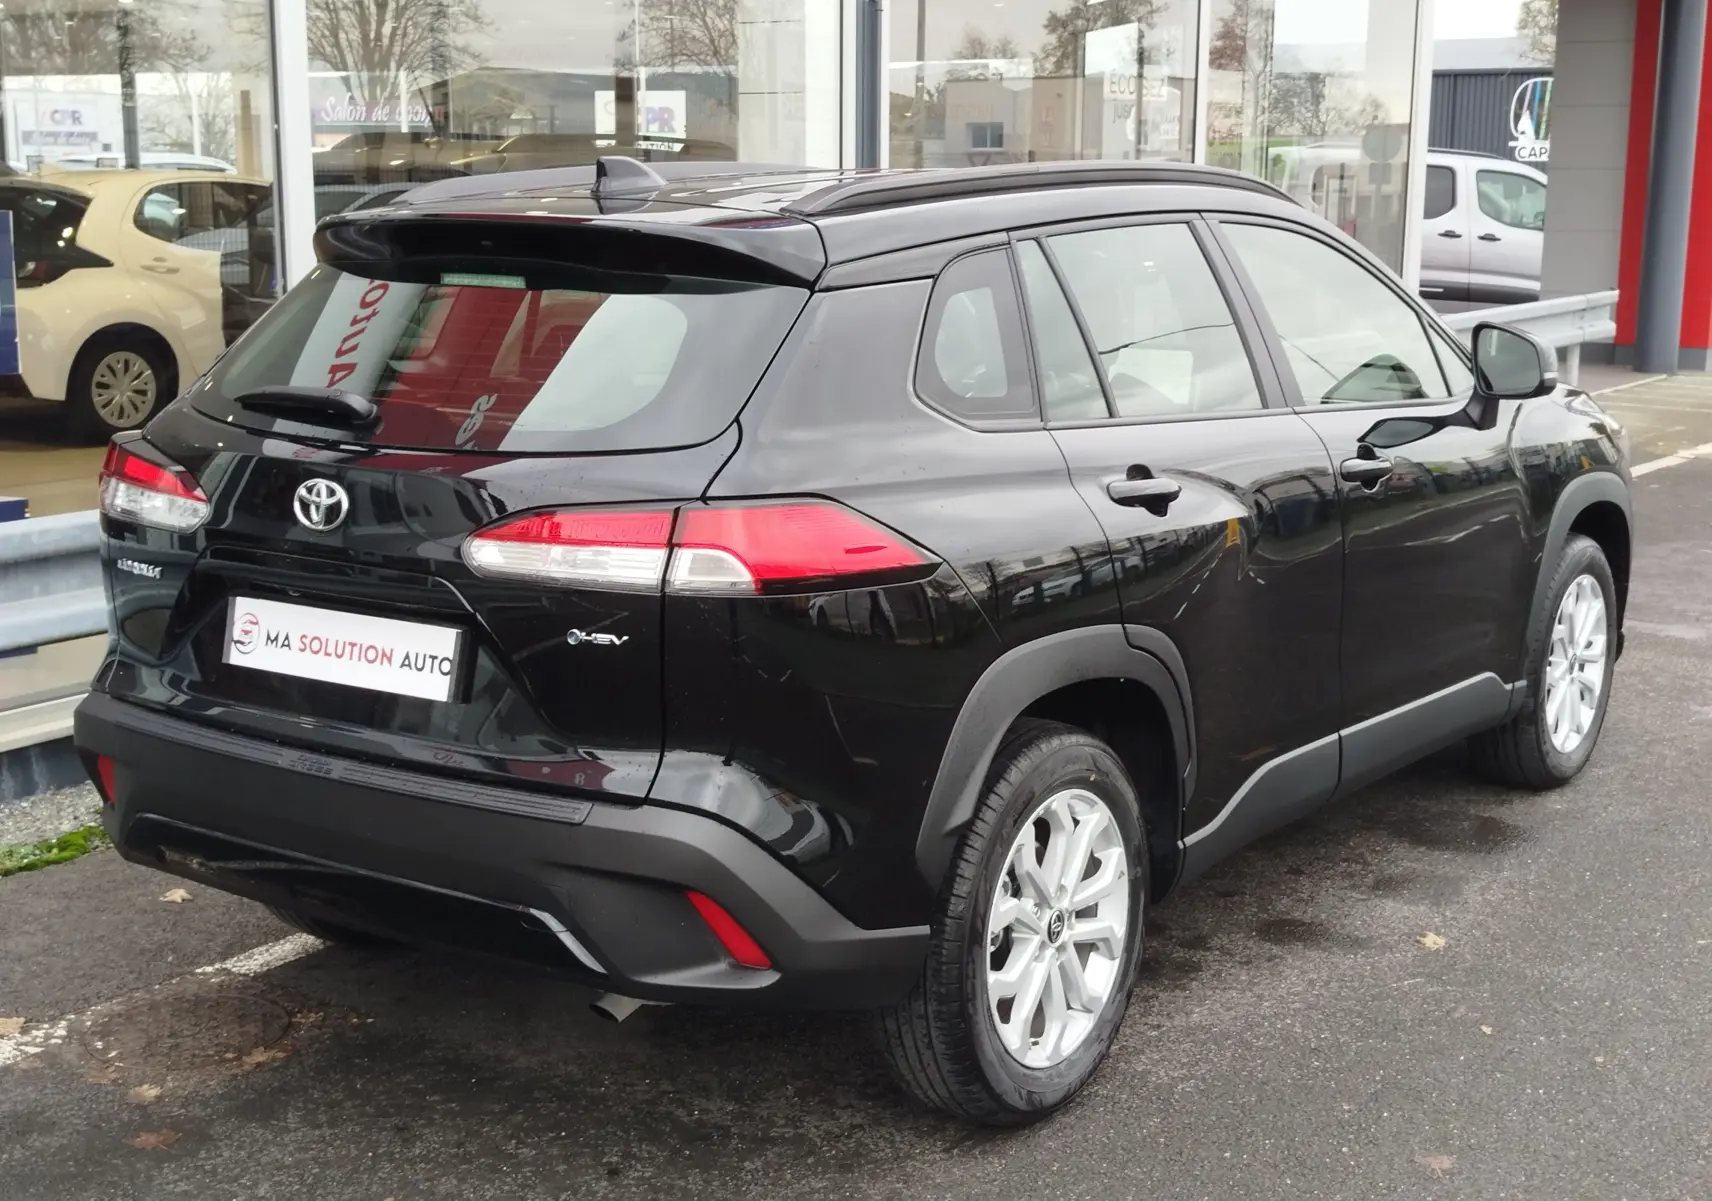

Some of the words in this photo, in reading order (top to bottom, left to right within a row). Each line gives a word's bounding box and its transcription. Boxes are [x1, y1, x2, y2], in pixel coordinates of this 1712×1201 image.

[321, 92, 366, 121] Salon
[372, 98, 390, 121] de
[1518, 146, 1549, 159] CAP
[581, 631, 629, 646] HEV
[265, 628, 292, 650] MA
[298, 633, 394, 667] SOLUTION
[399, 650, 453, 676] AUTO
